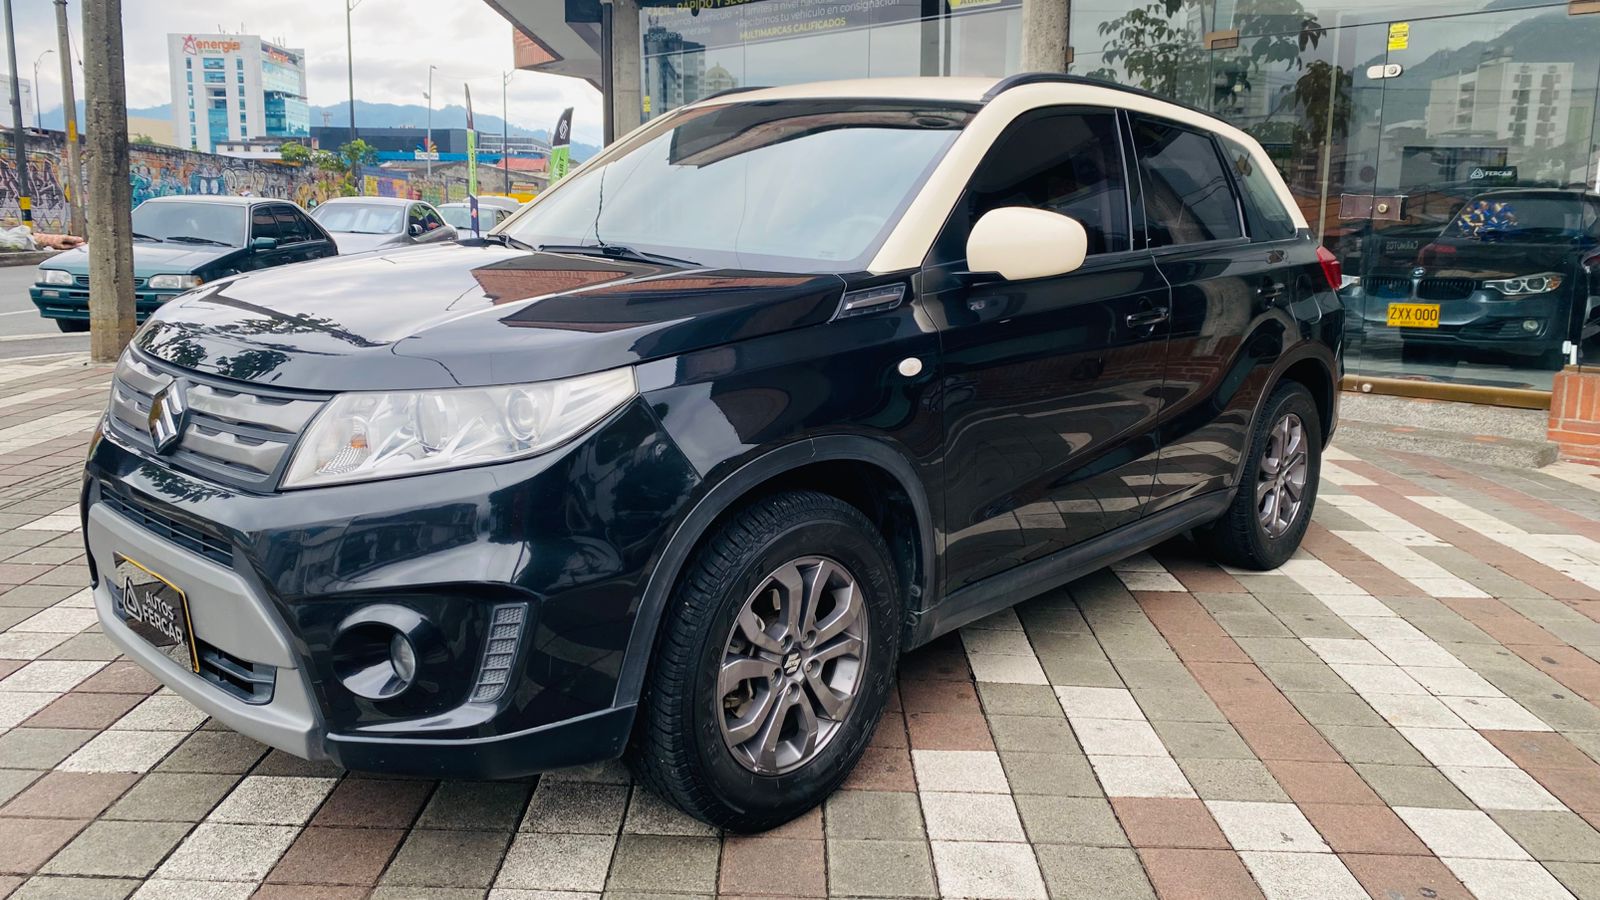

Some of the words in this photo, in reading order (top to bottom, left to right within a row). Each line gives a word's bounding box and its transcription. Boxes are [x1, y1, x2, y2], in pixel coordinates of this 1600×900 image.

[781, 13, 789, 21] tu
[827, 6, 838, 15] en
[740, 23, 792, 40] MULTIMARCAS
[793, 17, 847, 32] CALIFICADOS
[1390, 307, 1411, 320] ZXX
[1415, 308, 1438, 321] 000
[145, 590, 174, 621] AUTOS
[141, 603, 186, 647] FERCAR
